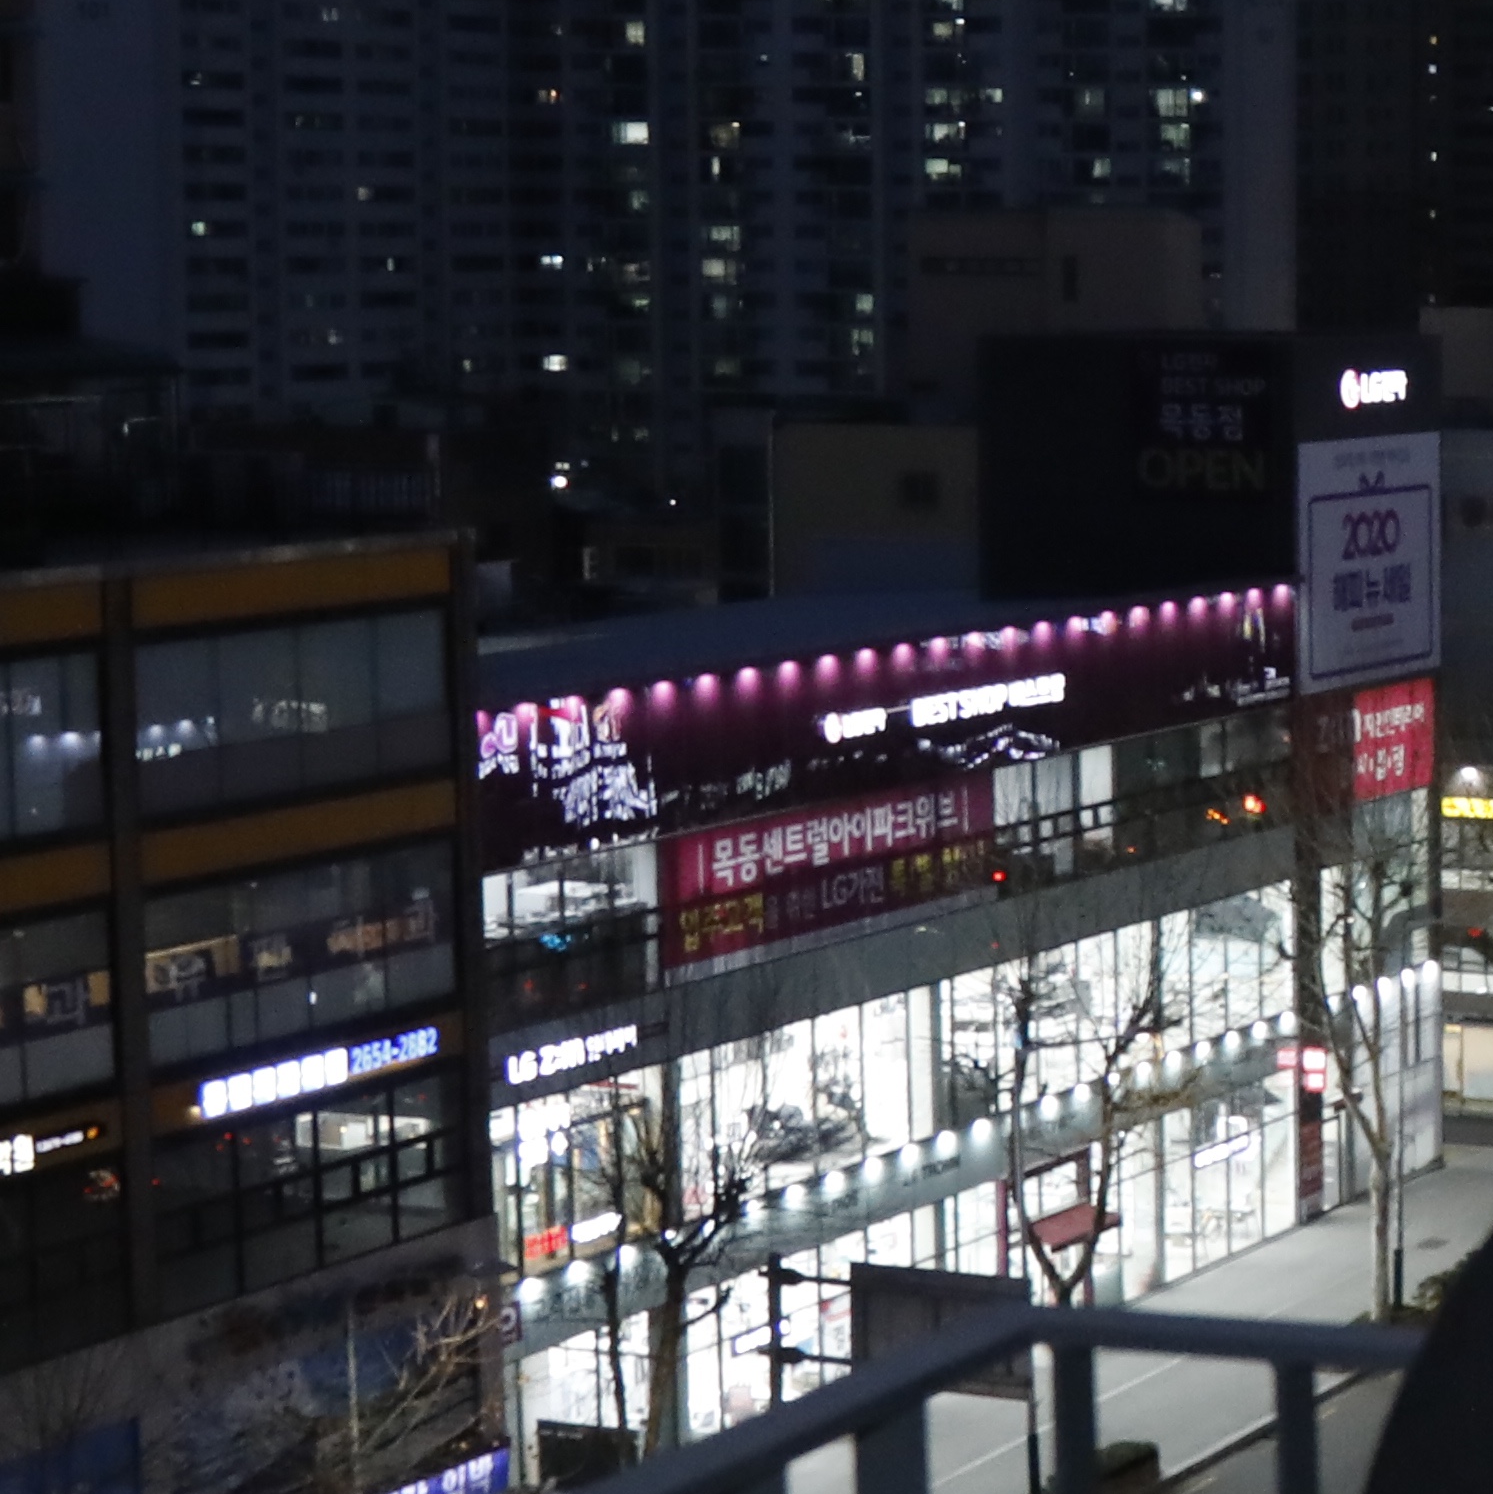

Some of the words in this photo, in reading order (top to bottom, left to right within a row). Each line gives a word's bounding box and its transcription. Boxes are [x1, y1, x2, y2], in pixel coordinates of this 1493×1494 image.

[1161, 376, 1207, 396] BEST
[1214, 376, 1267, 397] SHOP
[1159, 402, 1244, 442] 목동점
[1137, 447, 1266, 491] OPEN
[1342, 508, 1402, 561] 2020
[911, 691, 959, 727] BEST
[959, 683, 1009, 719] SHOP
[711, 791, 959, 887] 목동센트럴아이파크위브
